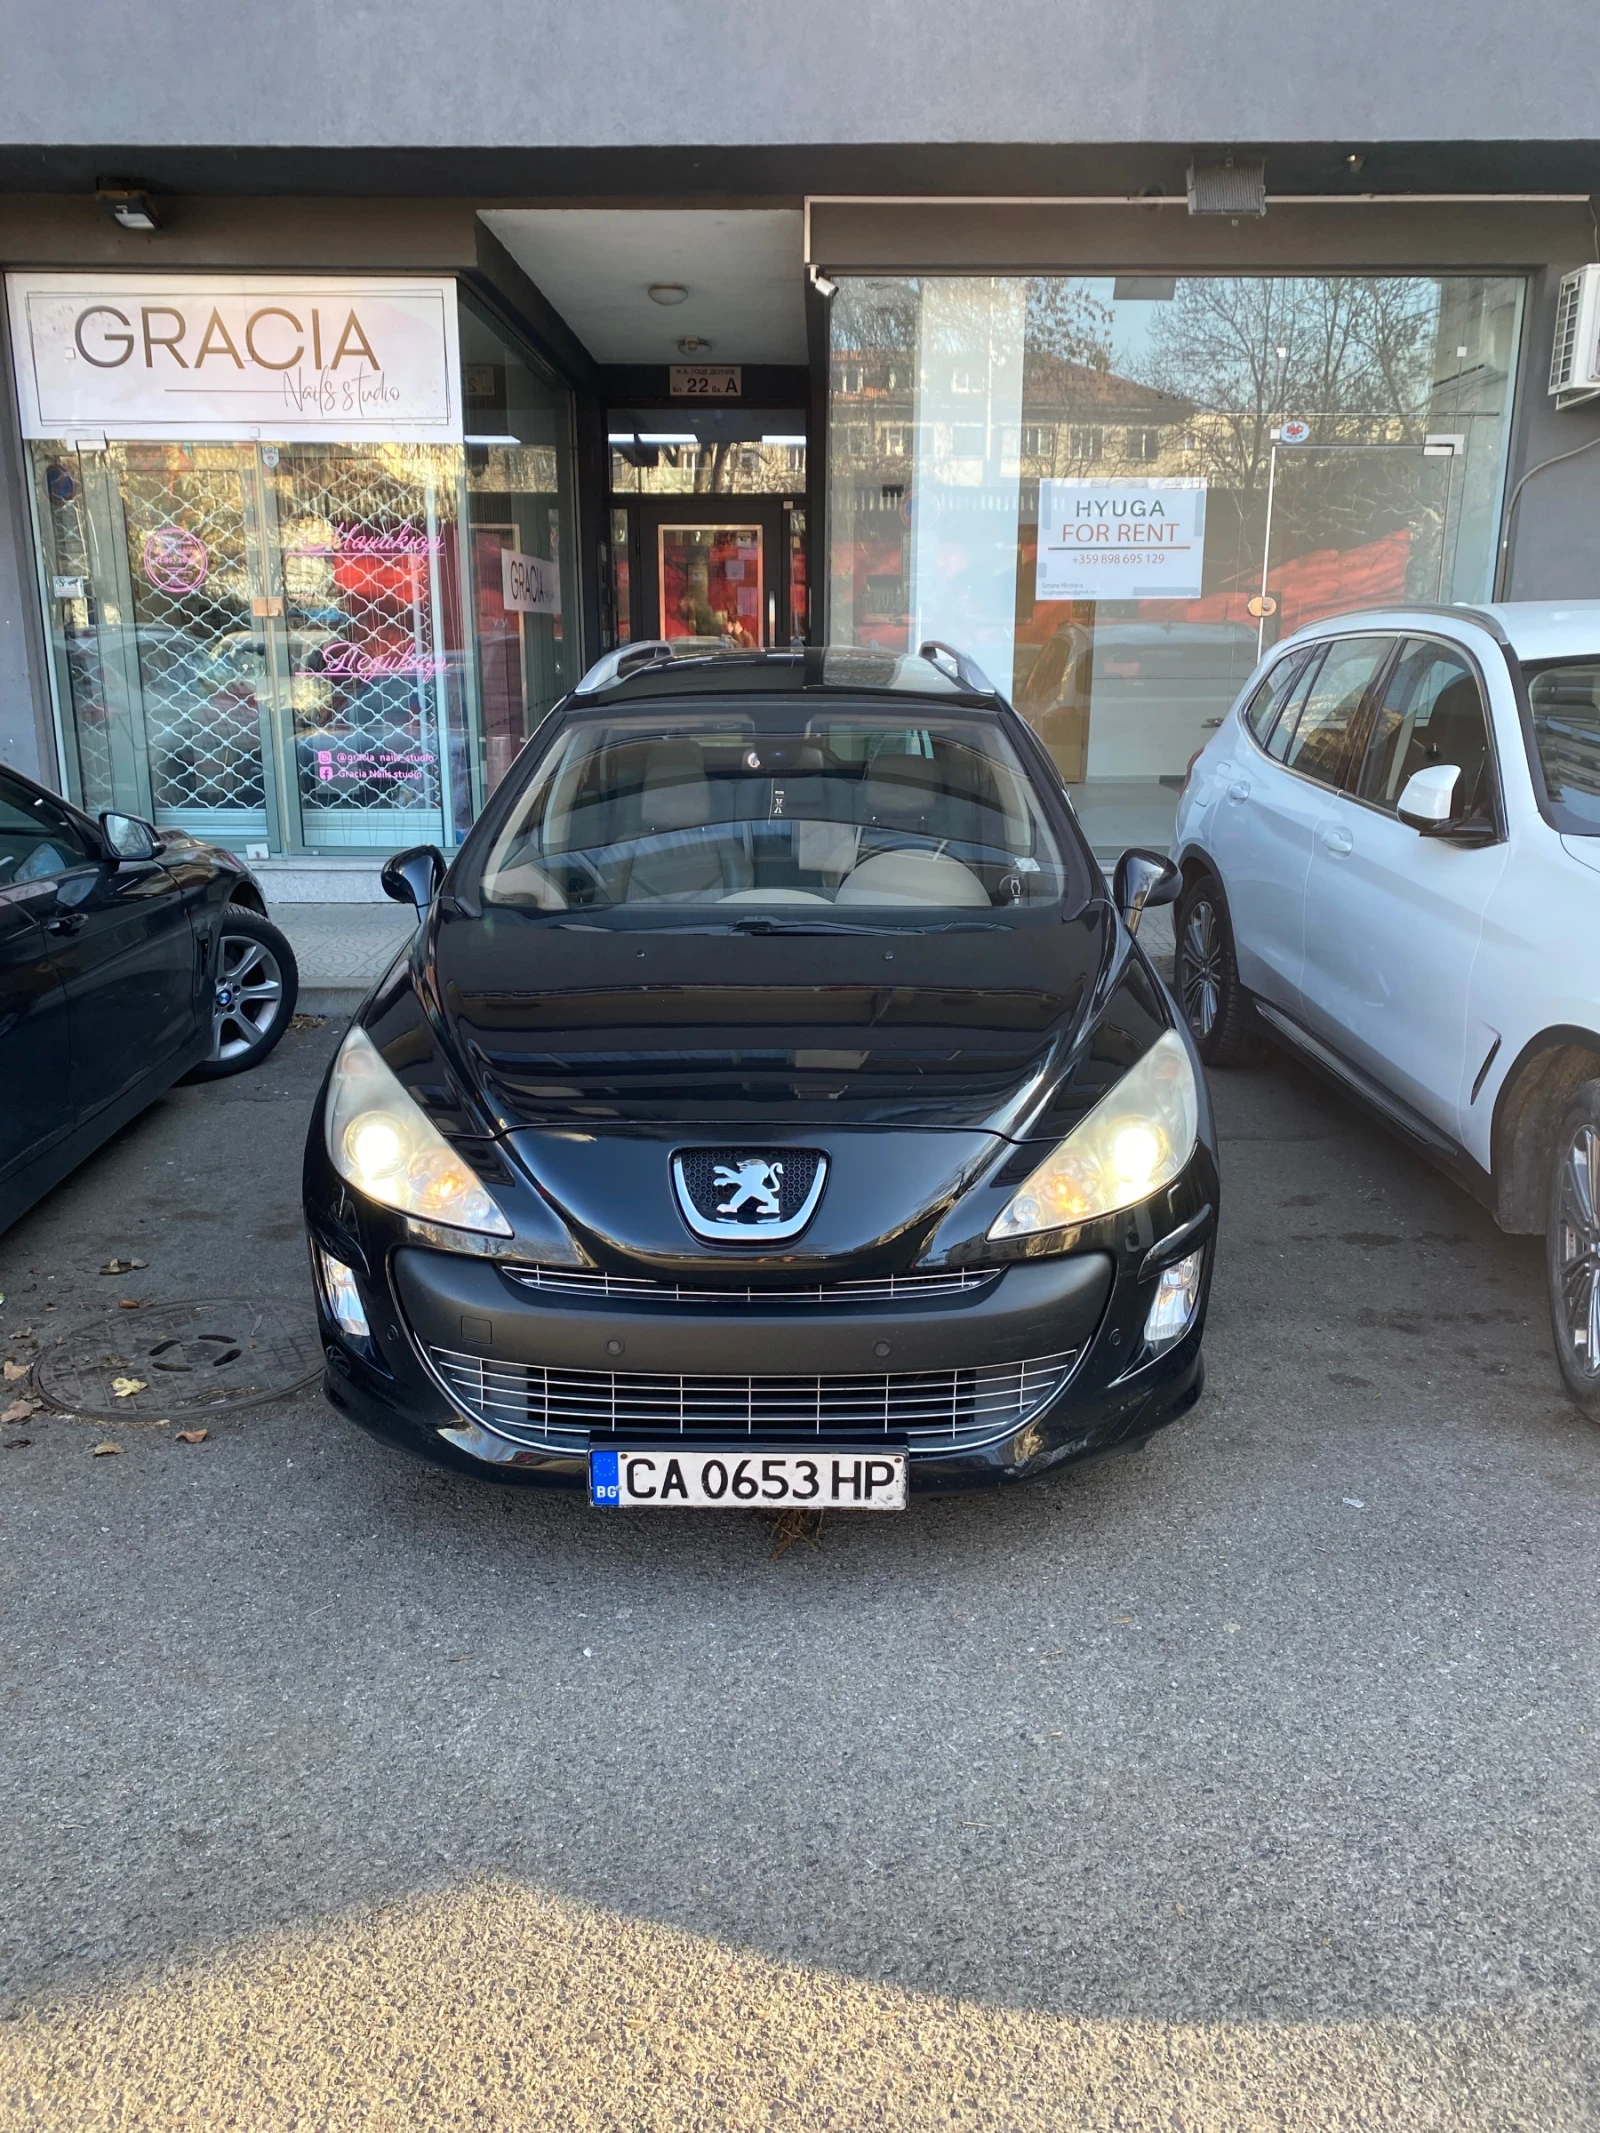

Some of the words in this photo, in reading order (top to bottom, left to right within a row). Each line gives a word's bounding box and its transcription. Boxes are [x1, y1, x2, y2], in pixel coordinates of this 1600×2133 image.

[74, 305, 381, 371] GRACIA
[283, 365, 337, 417] Nails
[342, 361, 401, 417] studio
[687, 377, 709, 393] 22
[725, 377, 738, 393] А
[1076, 499, 1165, 518] HYUGA
[1062, 523, 1110, 543] FOR
[1118, 523, 1181, 542] RENT
[1072, 554, 1099, 565] +359
[1101, 553, 1121, 564] 898
[1123, 553, 1143, 564] 695
[1146, 553, 1165, 564] 129
[510, 560, 545, 603] GRACIA
[322, 641, 450, 683] Педикюр
[338, 769, 367, 778] Gracia
[369, 770, 392, 779] Nails
[393, 770, 422, 780] studio
[626, 1458, 688, 1499] CA
[701, 1459, 820, 1500] 0653
[831, 1460, 895, 1501] HP
[596, 1486, 617, 1498] BG
